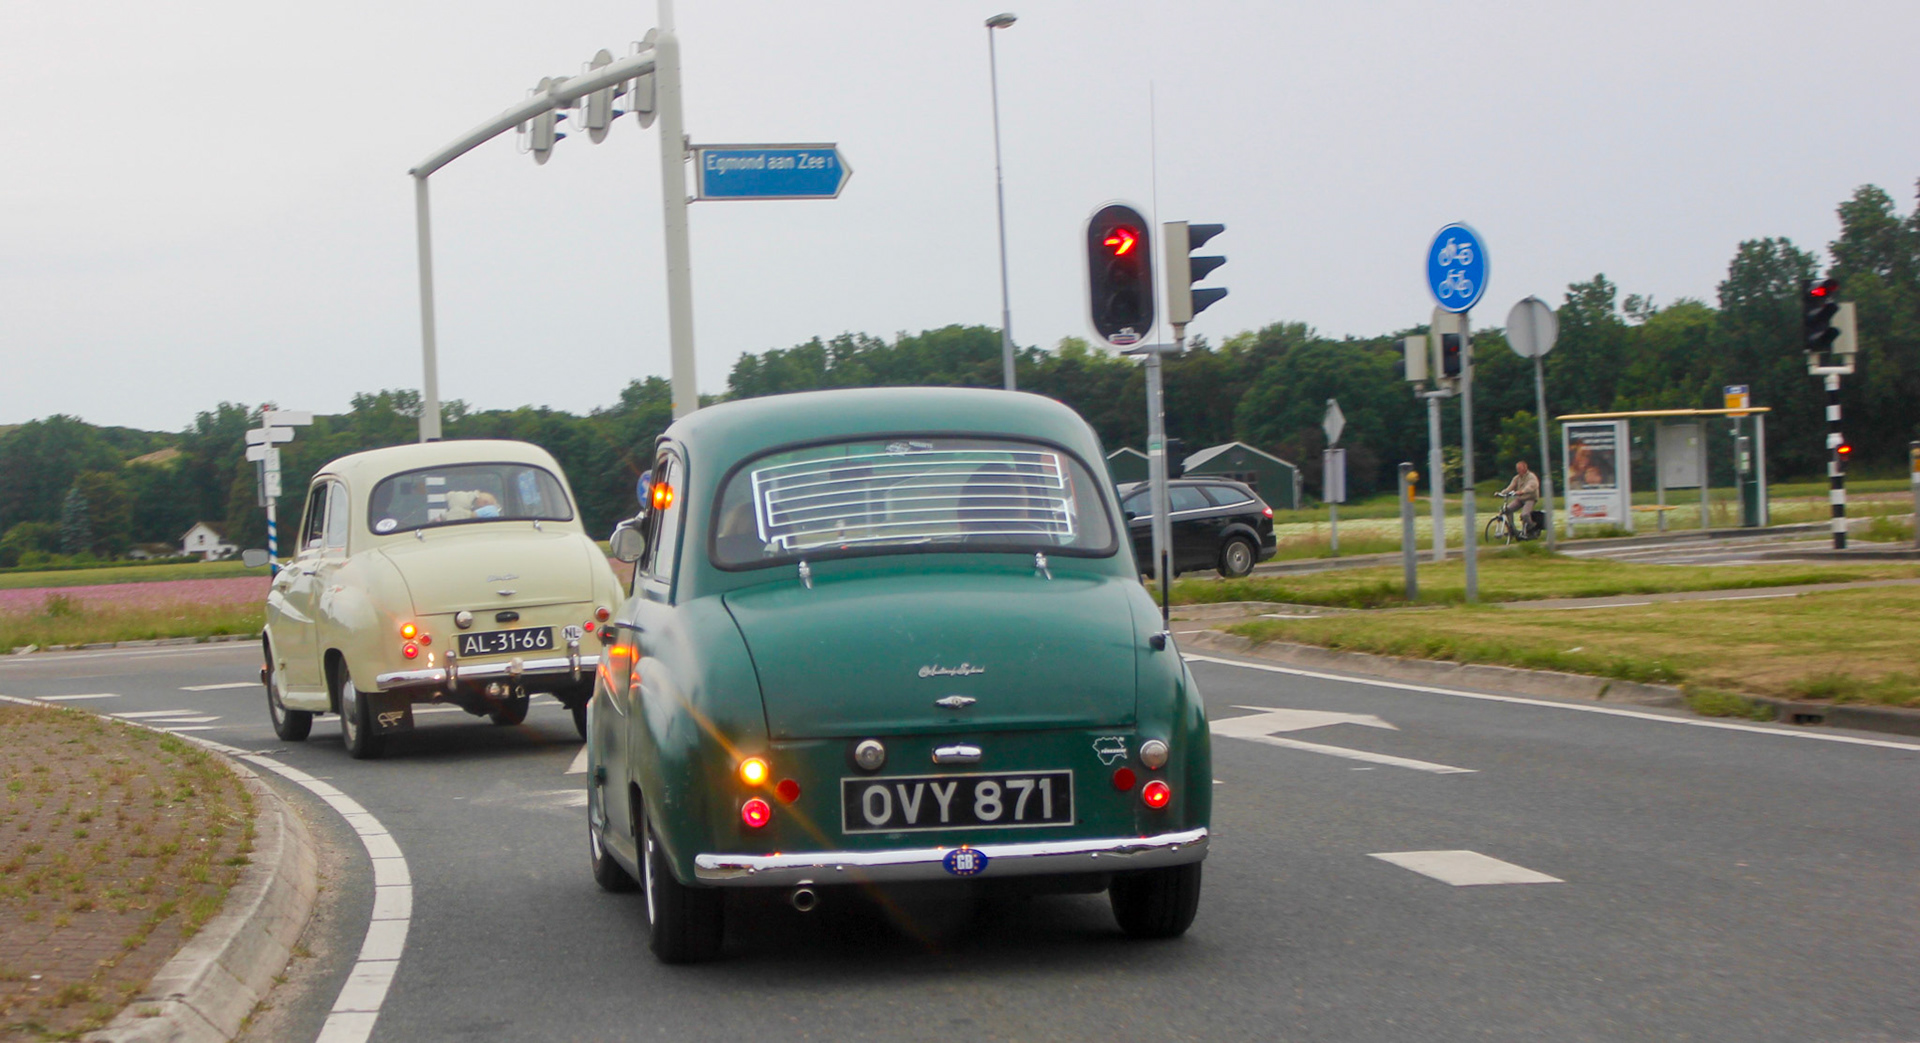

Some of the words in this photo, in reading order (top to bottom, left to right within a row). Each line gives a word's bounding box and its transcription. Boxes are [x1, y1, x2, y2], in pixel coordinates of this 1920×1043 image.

[706, 154, 766, 175] Egmond
[767, 156, 795, 169] aan
[797, 153, 826, 169] Zee
[464, 630, 548, 654] AL-31-66
[564, 627, 579, 638] NL
[862, 781, 958, 826] OVY
[973, 778, 1052, 821] 871
[956, 854, 974, 870] GB
